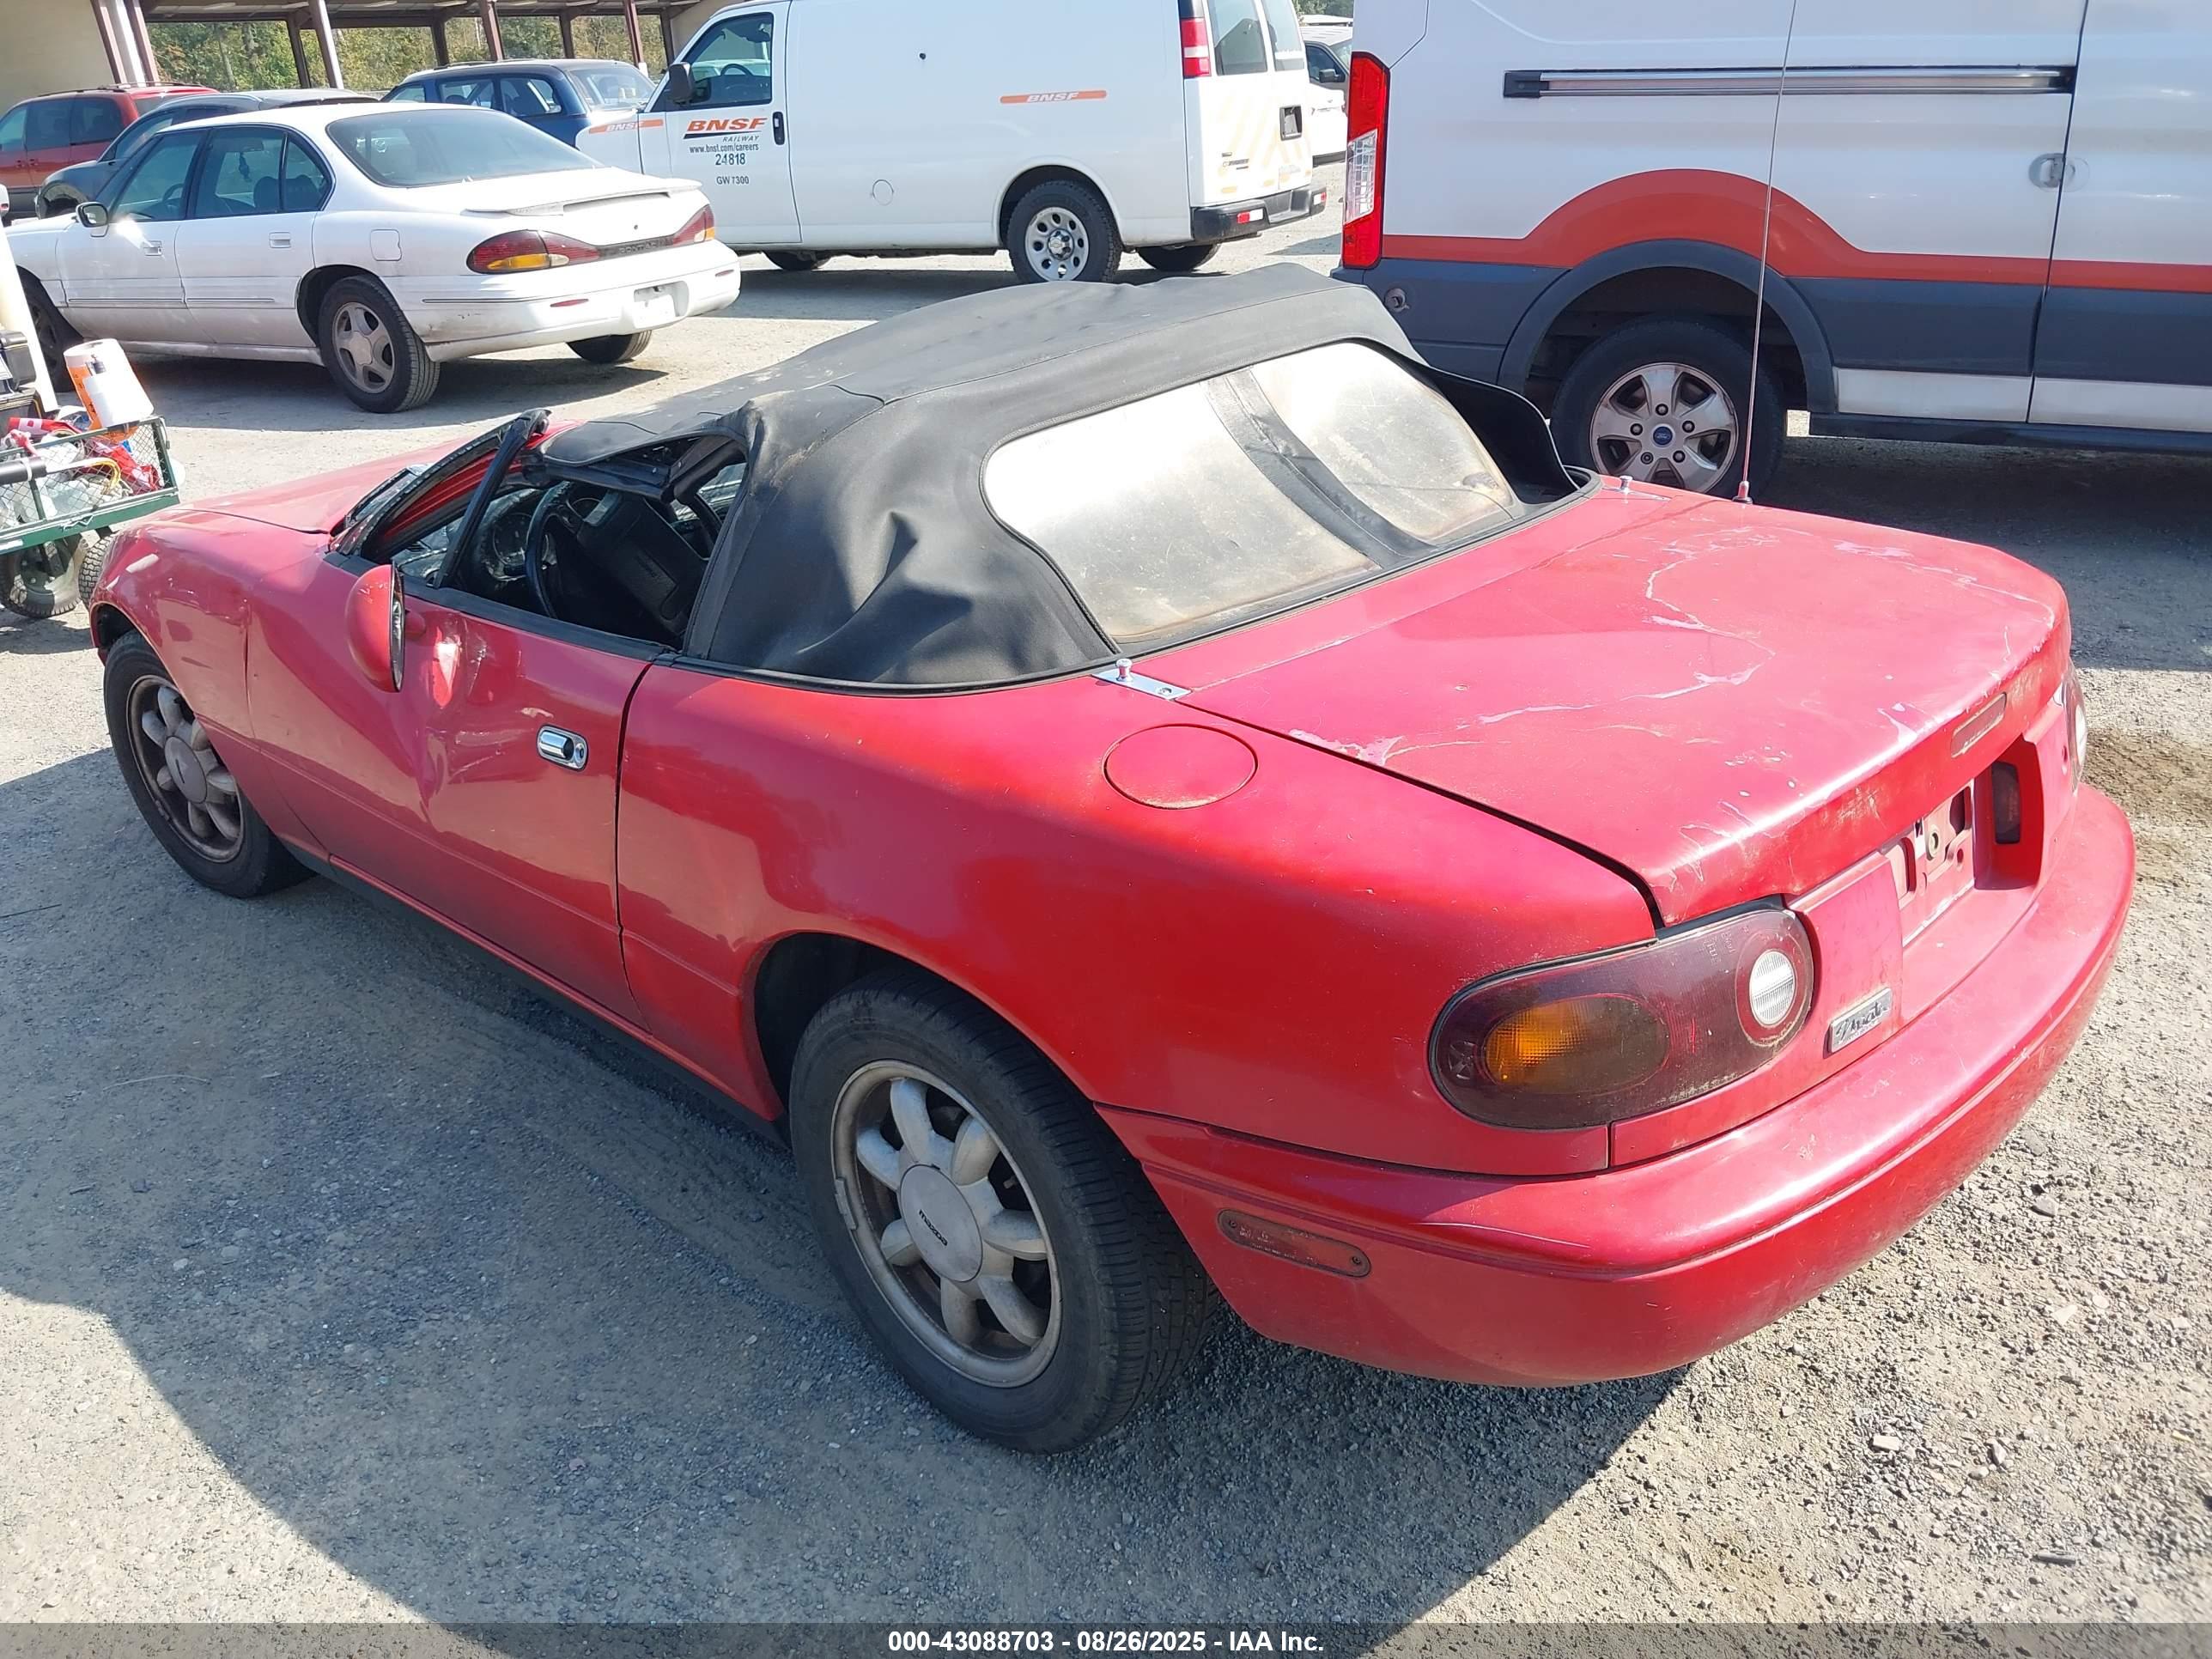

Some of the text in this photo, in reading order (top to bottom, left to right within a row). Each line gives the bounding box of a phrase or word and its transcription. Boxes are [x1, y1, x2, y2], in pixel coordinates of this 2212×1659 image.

[1027, 92, 1079, 102] BNSF
[687, 118, 768, 131] BNSF
[714, 153, 746, 166] 24818
[716, 175, 750, 185] GW 7300
